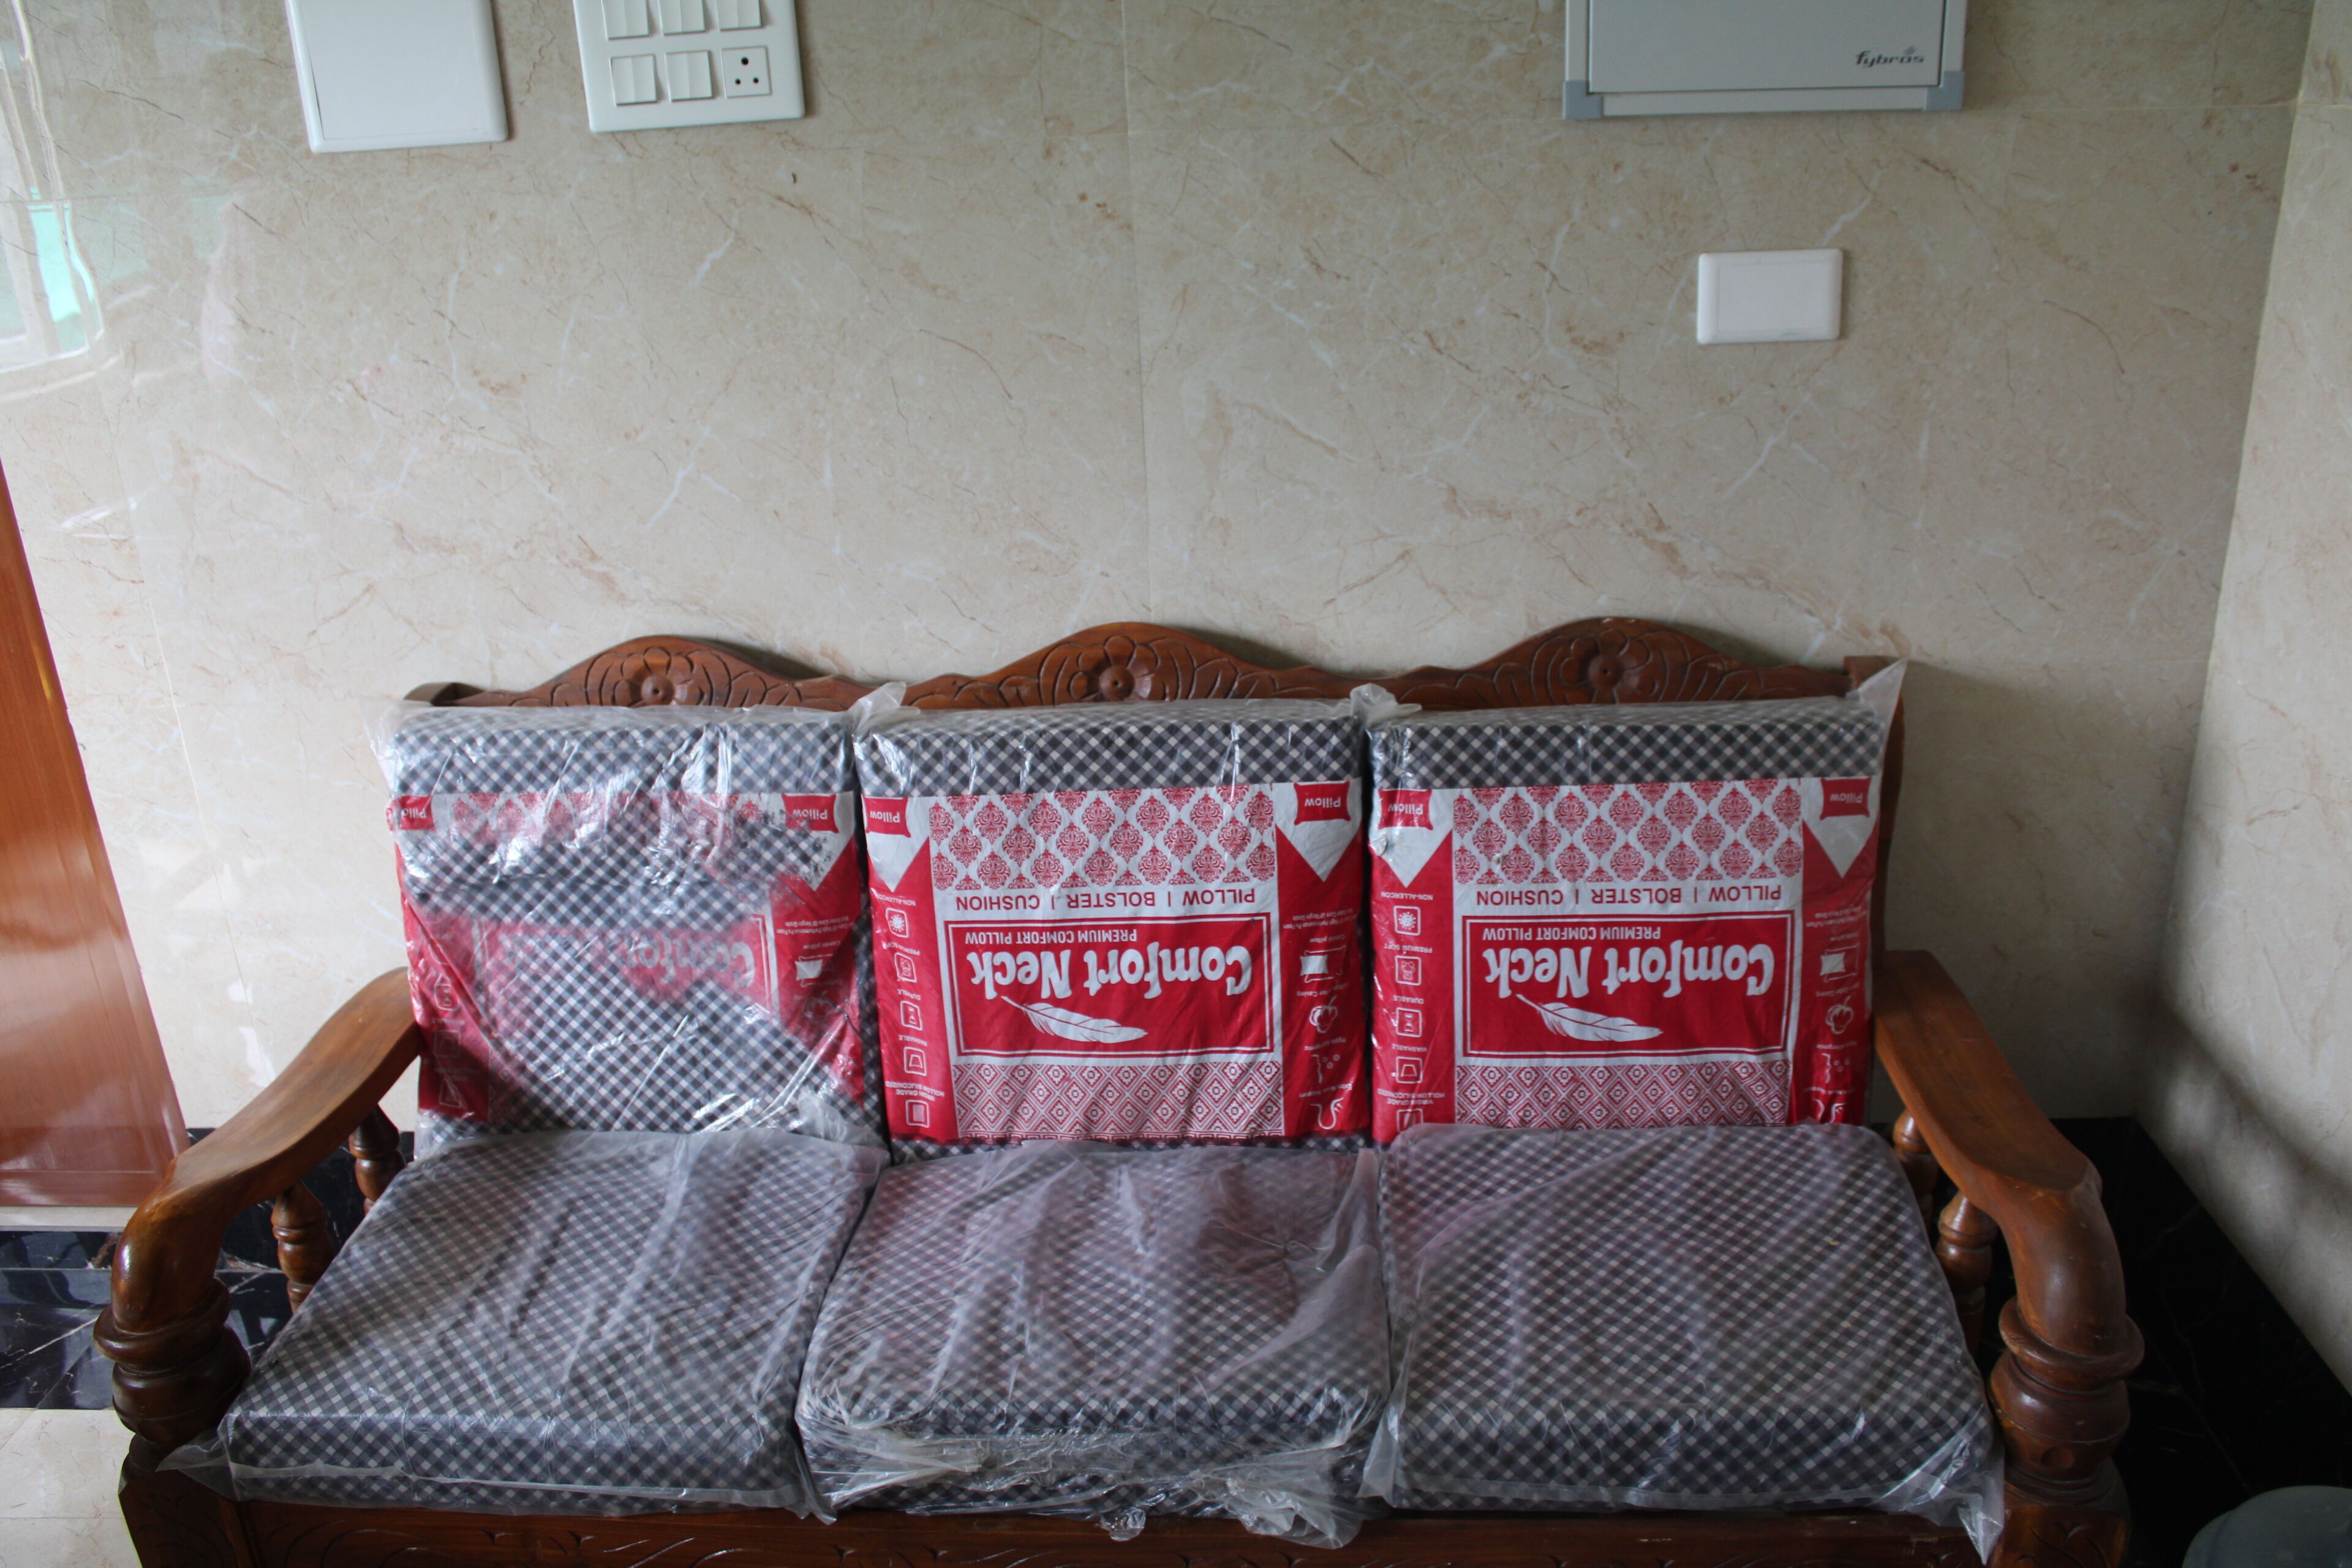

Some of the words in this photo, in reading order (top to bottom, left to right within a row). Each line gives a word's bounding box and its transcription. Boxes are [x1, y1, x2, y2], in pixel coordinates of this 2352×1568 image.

[1855, 49, 1925, 68] fybros
[1304, 797, 1341, 809] Pillow
[1830, 792, 1863, 804] Pillow
[791, 809, 829, 821] Pillow
[1388, 802, 1424, 816] Pillow
[870, 810, 900, 823] Pillow
[1066, 891, 1155, 908] BOLSTER
[1182, 888, 1255, 907] PILLOW
[1476, 889, 1564, 906] CUSHION
[1591, 888, 1682, 905] BOLSTER
[1708, 884, 1782, 903] PILLOW
[955, 895, 1040, 910] CUSHION
[965, 932, 1013, 944] PILLOW
[1016, 930, 1075, 944] COMFORT
[1077, 929, 1137, 943] PREMIUM
[1482, 927, 1533, 941] PILLOW
[1537, 927, 1597, 940] COMFORT
[1600, 926, 1661, 940] PREMIUM
[966, 949, 1072, 1000] Neck
[1083, 941, 1252, 999] Comfort
[1482, 946, 1592, 999] Neck
[1601, 939, 1774, 998] Comfort
[1393, 995, 1424, 1005] DURABLE
[884, 1080, 922, 1090] SILICONIZED
